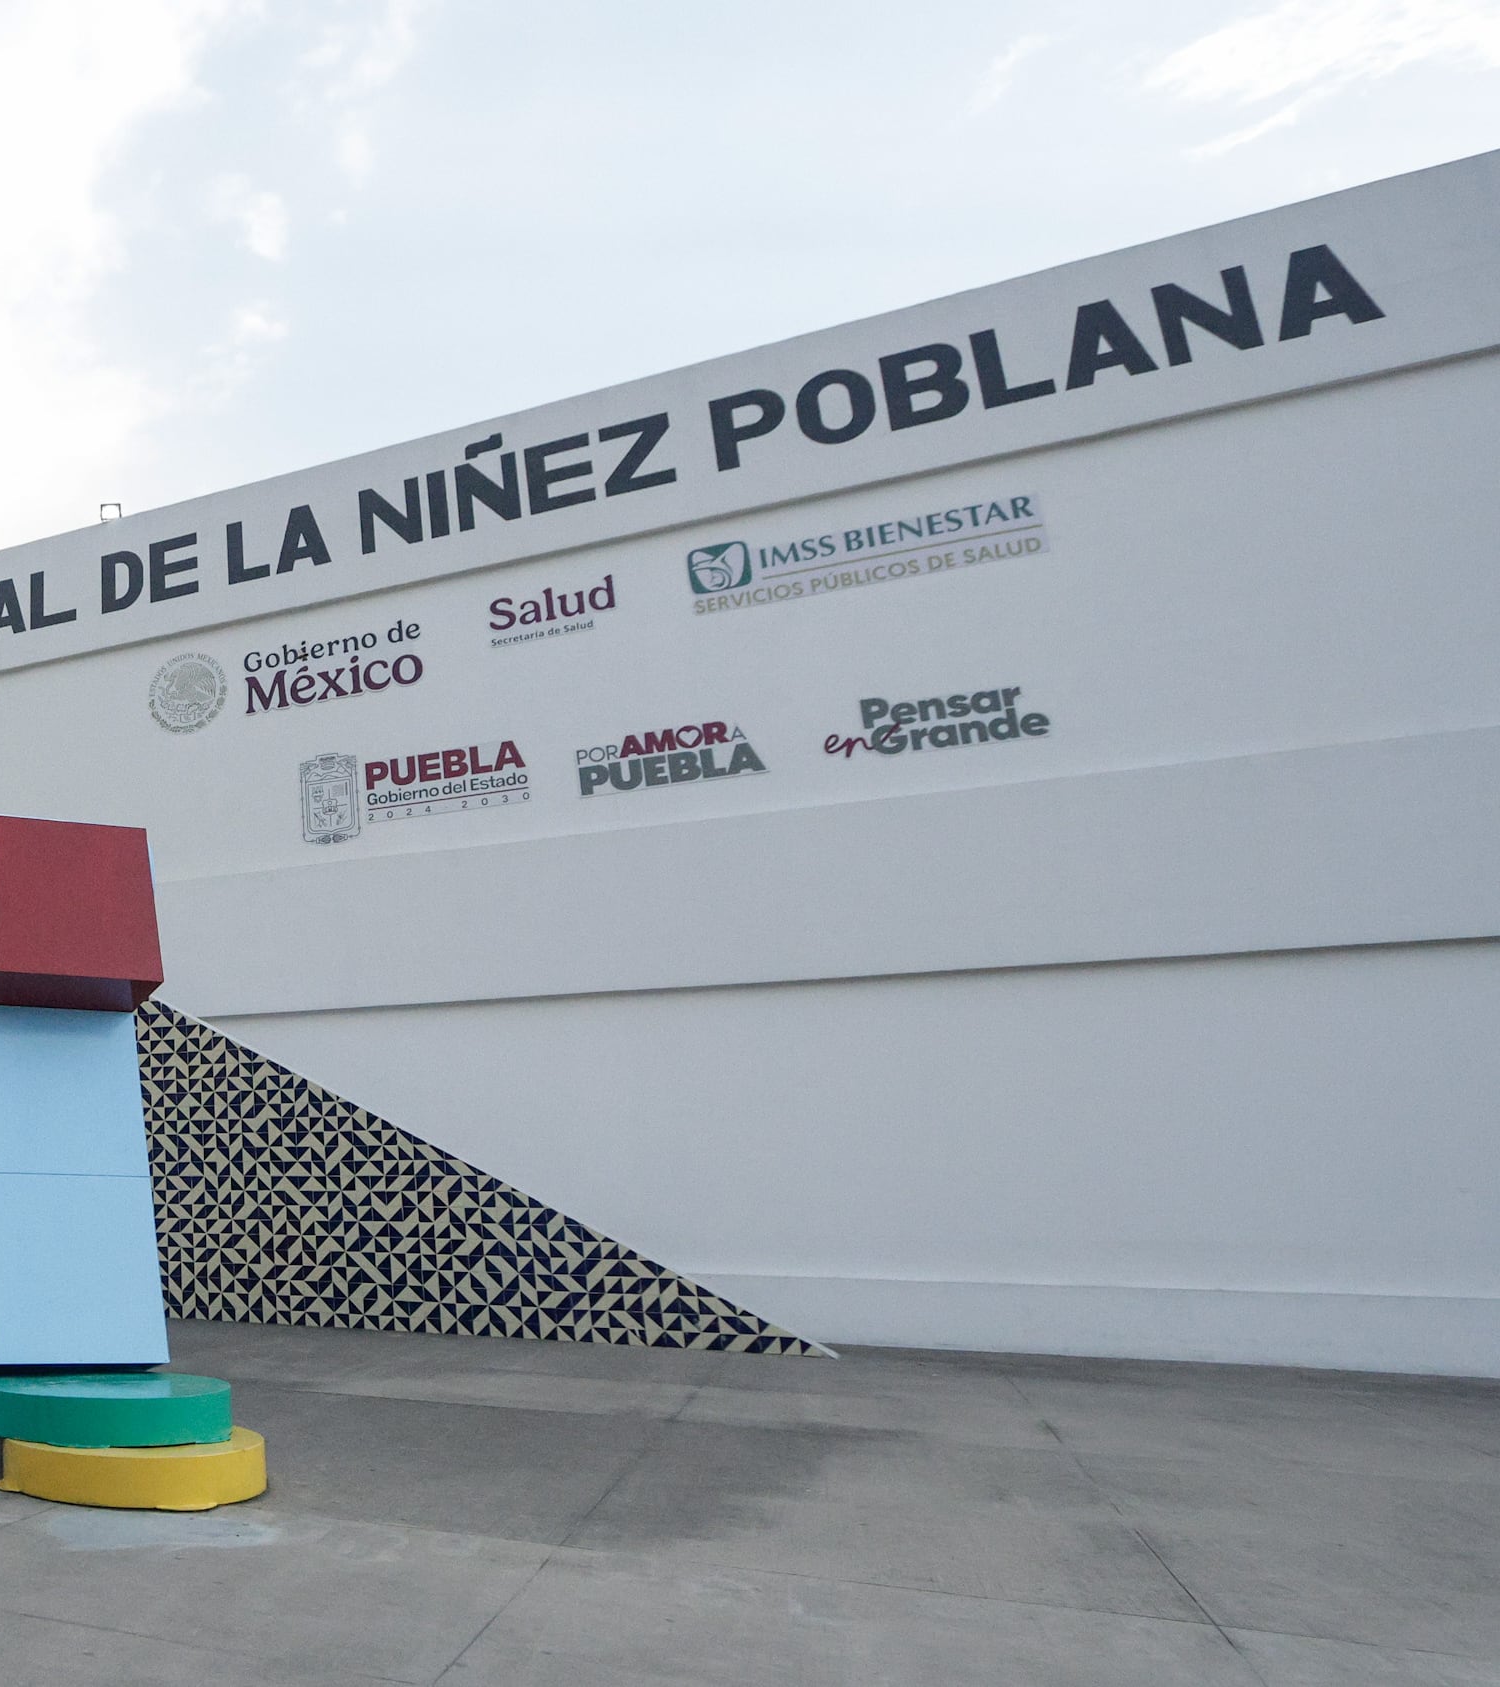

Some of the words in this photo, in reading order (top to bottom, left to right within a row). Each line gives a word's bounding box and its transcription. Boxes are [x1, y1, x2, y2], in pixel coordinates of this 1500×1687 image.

[100, 532, 199, 615] DE
[226, 504, 332, 586] LA
[358, 412, 677, 556] NIÑEZ
[708, 243, 1386, 472] POBLANA
[759, 535, 836, 568] IMSS
[844, 496, 1034, 552] BIENESTAR
[490, 574, 615, 630] Salud
[694, 581, 802, 615] SERVICIOS
[811, 559, 920, 592] PÚBLICOS
[928, 551, 956, 572] DE
[963, 537, 1042, 563] SALUD
[244, 632, 377, 672] Gobierno
[387, 619, 421, 643] de
[548, 627, 560, 636] de
[564, 620, 594, 632] Salud
[167, 653, 195, 667] UNIDOS
[245, 654, 423, 714] México
[824, 733, 880, 758] en
[871, 707, 1050, 755] Grande
[860, 687, 1021, 729] Pensar
[365, 740, 526, 790] PUEBLA
[576, 745, 620, 764] POR
[620, 721, 731, 758] AMOR
[731, 726, 747, 741] A
[579, 742, 766, 795] PUEBLA
[367, 786, 439, 806] Gobierno
[442, 780, 466, 795] del
[470, 773, 528, 791] Estado
